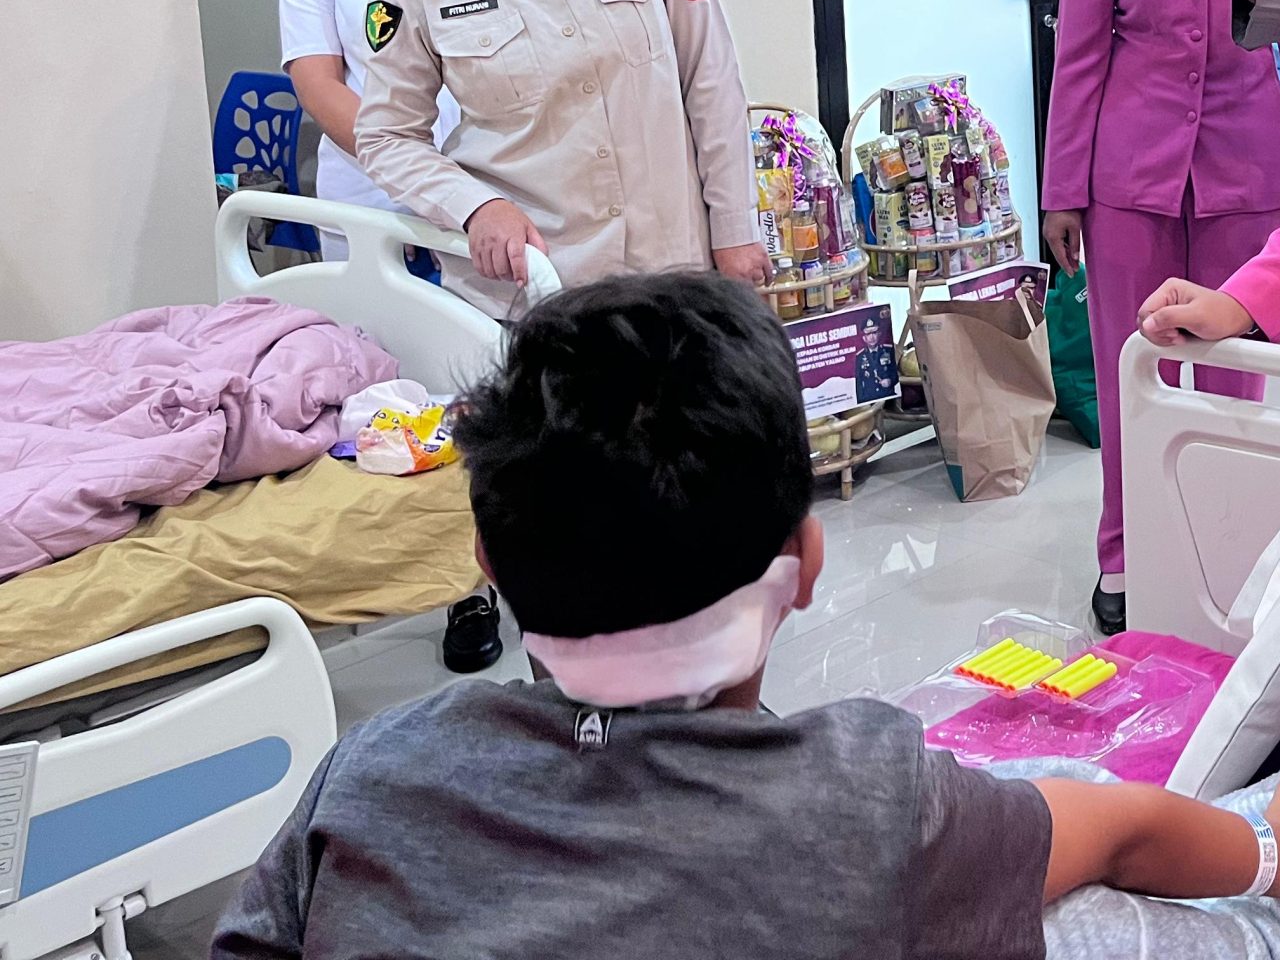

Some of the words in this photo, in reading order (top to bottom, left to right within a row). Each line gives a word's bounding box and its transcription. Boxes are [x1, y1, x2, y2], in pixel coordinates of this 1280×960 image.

[449, 6, 466, 15] FITRI
[765, 212, 779, 254] Wafello
[806, 332, 828, 347] LEKAS
